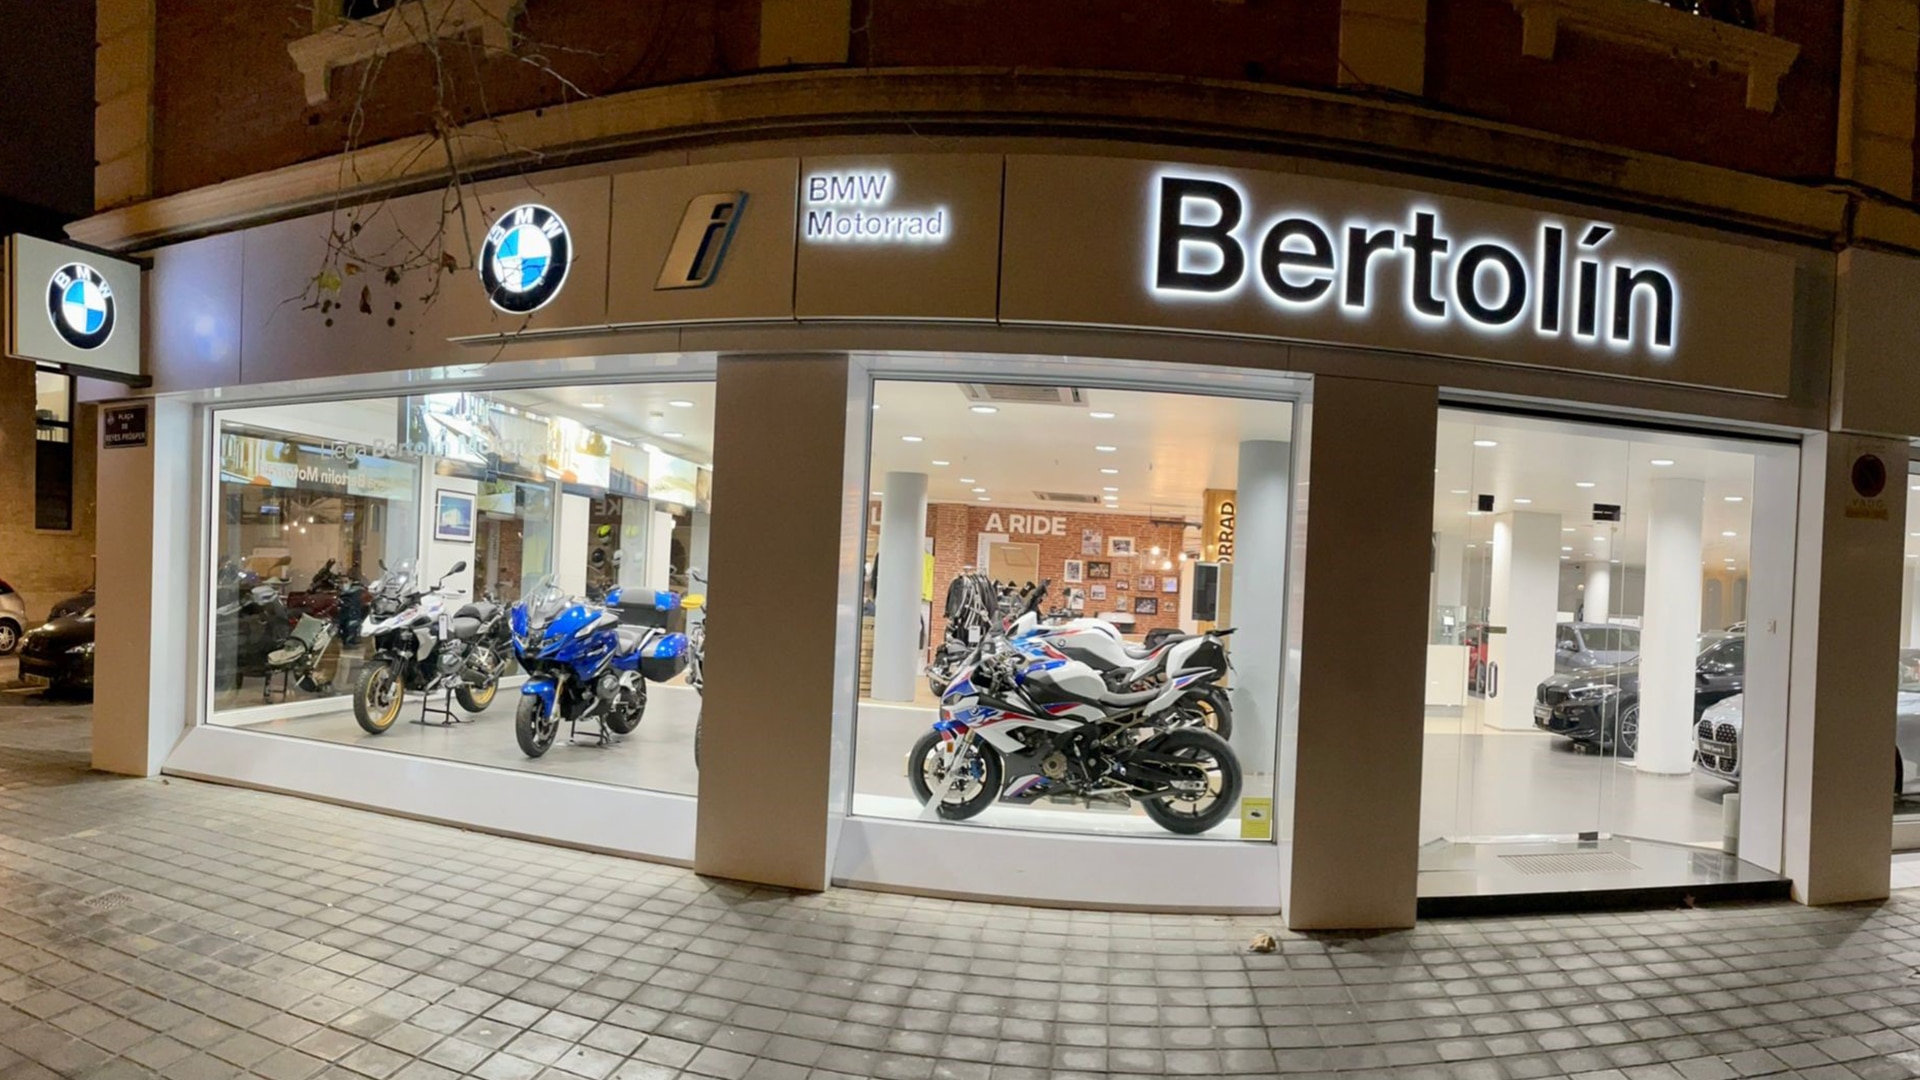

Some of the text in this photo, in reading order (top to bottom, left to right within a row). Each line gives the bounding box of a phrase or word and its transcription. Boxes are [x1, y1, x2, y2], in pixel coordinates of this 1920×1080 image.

[809, 175, 888, 202] BMW
[489, 206, 564, 247] BMW
[807, 211, 943, 236] Motorrad
[1156, 175, 1675, 347] Bertolín
[54, 264, 112, 299] BMW
[320, 441, 367, 464] Llega
[985, 513, 1005, 532] A
[1009, 514, 1067, 536] RIDE
